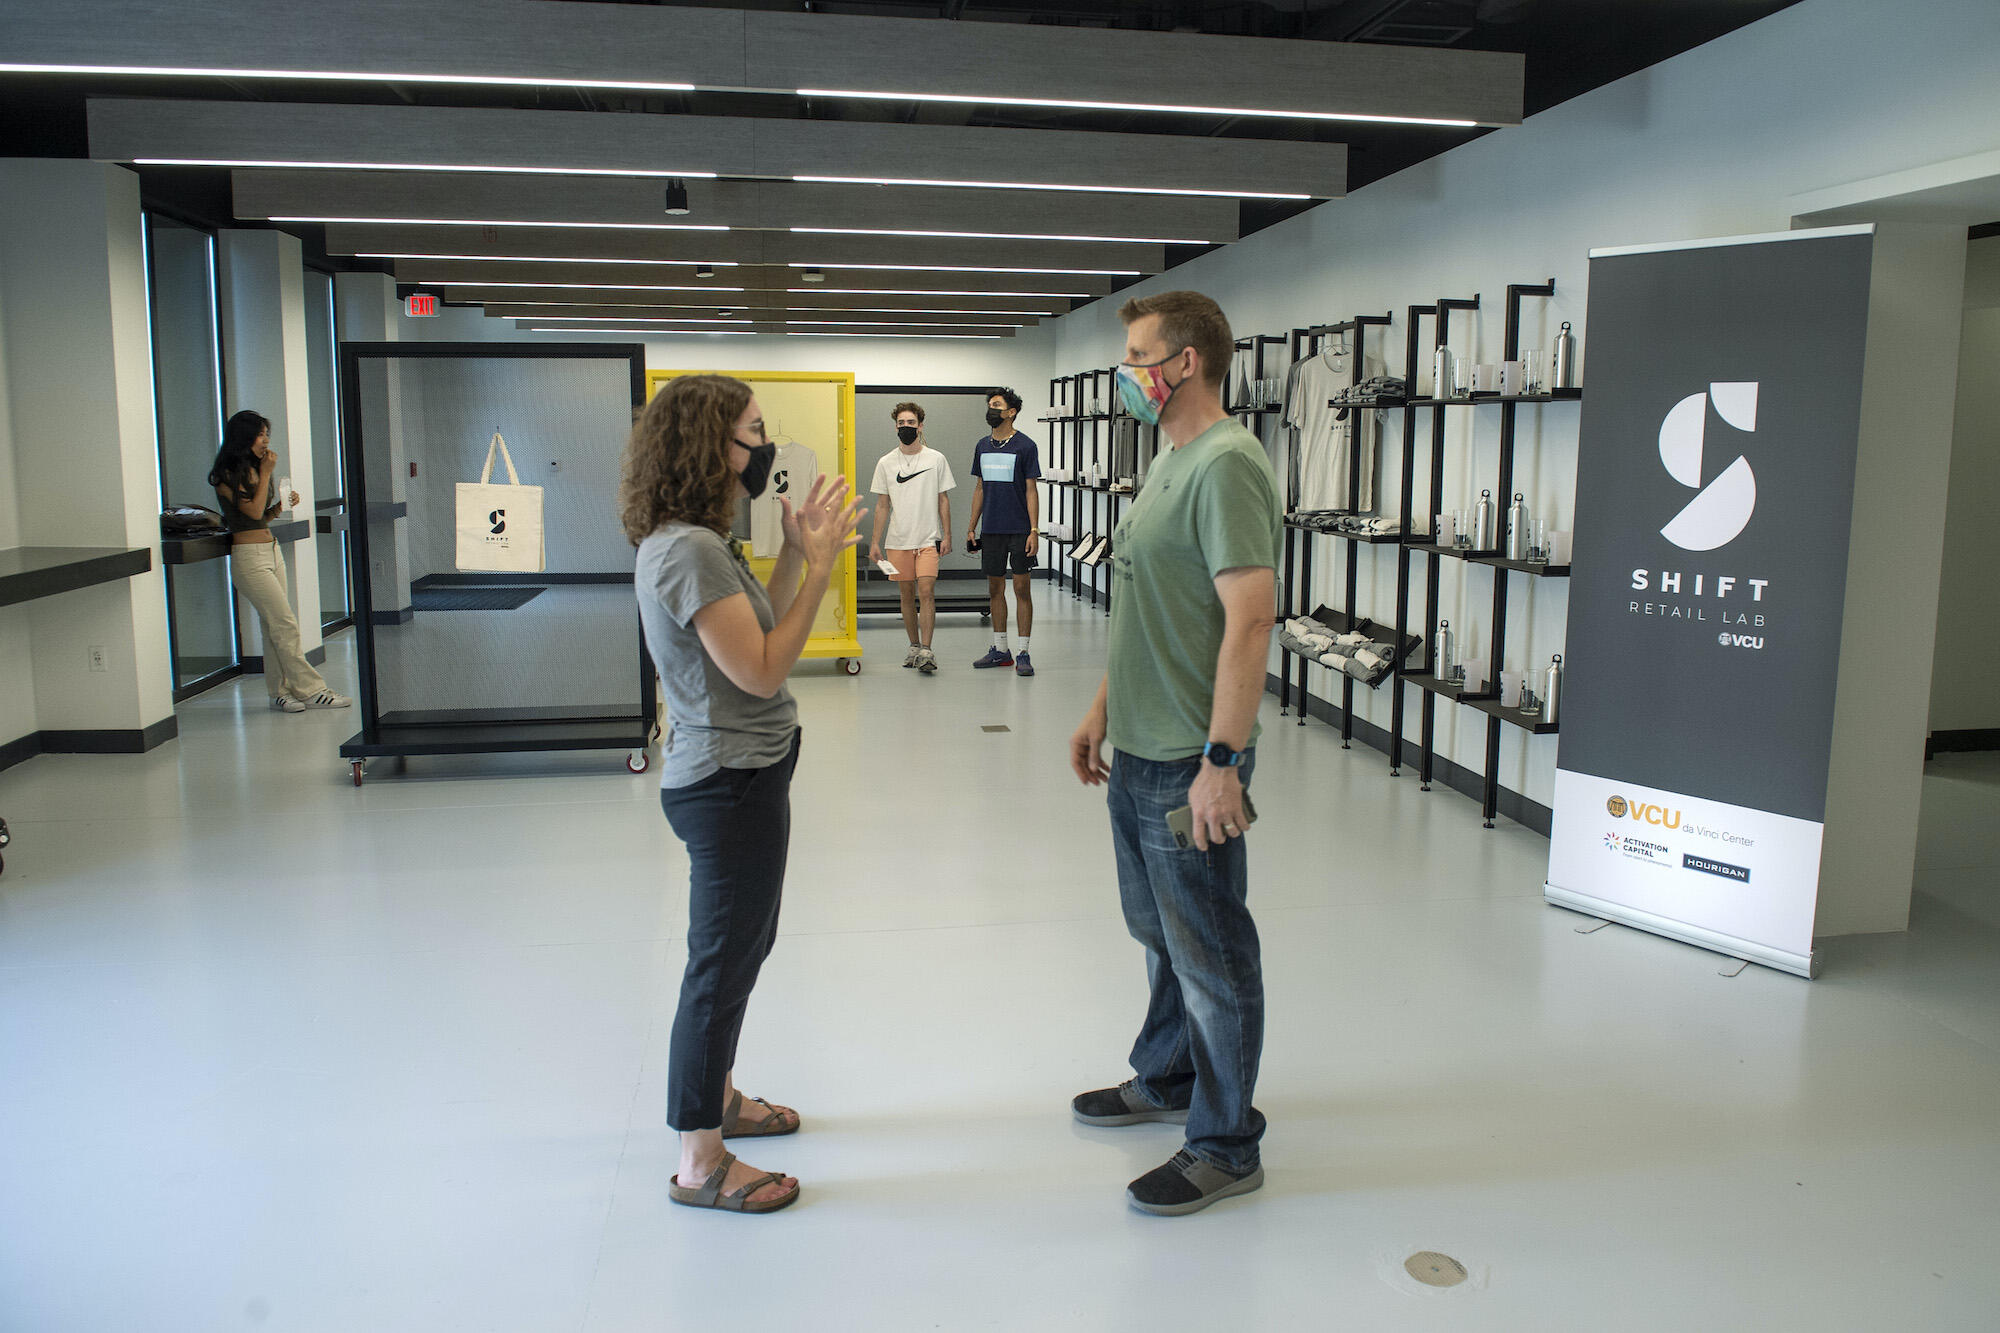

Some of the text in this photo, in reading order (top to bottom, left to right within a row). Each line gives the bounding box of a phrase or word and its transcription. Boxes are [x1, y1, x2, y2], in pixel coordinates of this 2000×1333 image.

[409, 296, 435, 316] EXIT
[1631, 568, 1769, 602] SHIFT
[1629, 601, 1766, 627] RETAIL LAB
[1732, 634, 1765, 650] VCU
[1629, 799, 1755, 847] VCU da Vinci Center
[1622, 844, 1655, 858] CAPITAL
[1623, 836, 1669, 853] ACTIVATION
[1686, 858, 1746, 878] HOURIGAN
